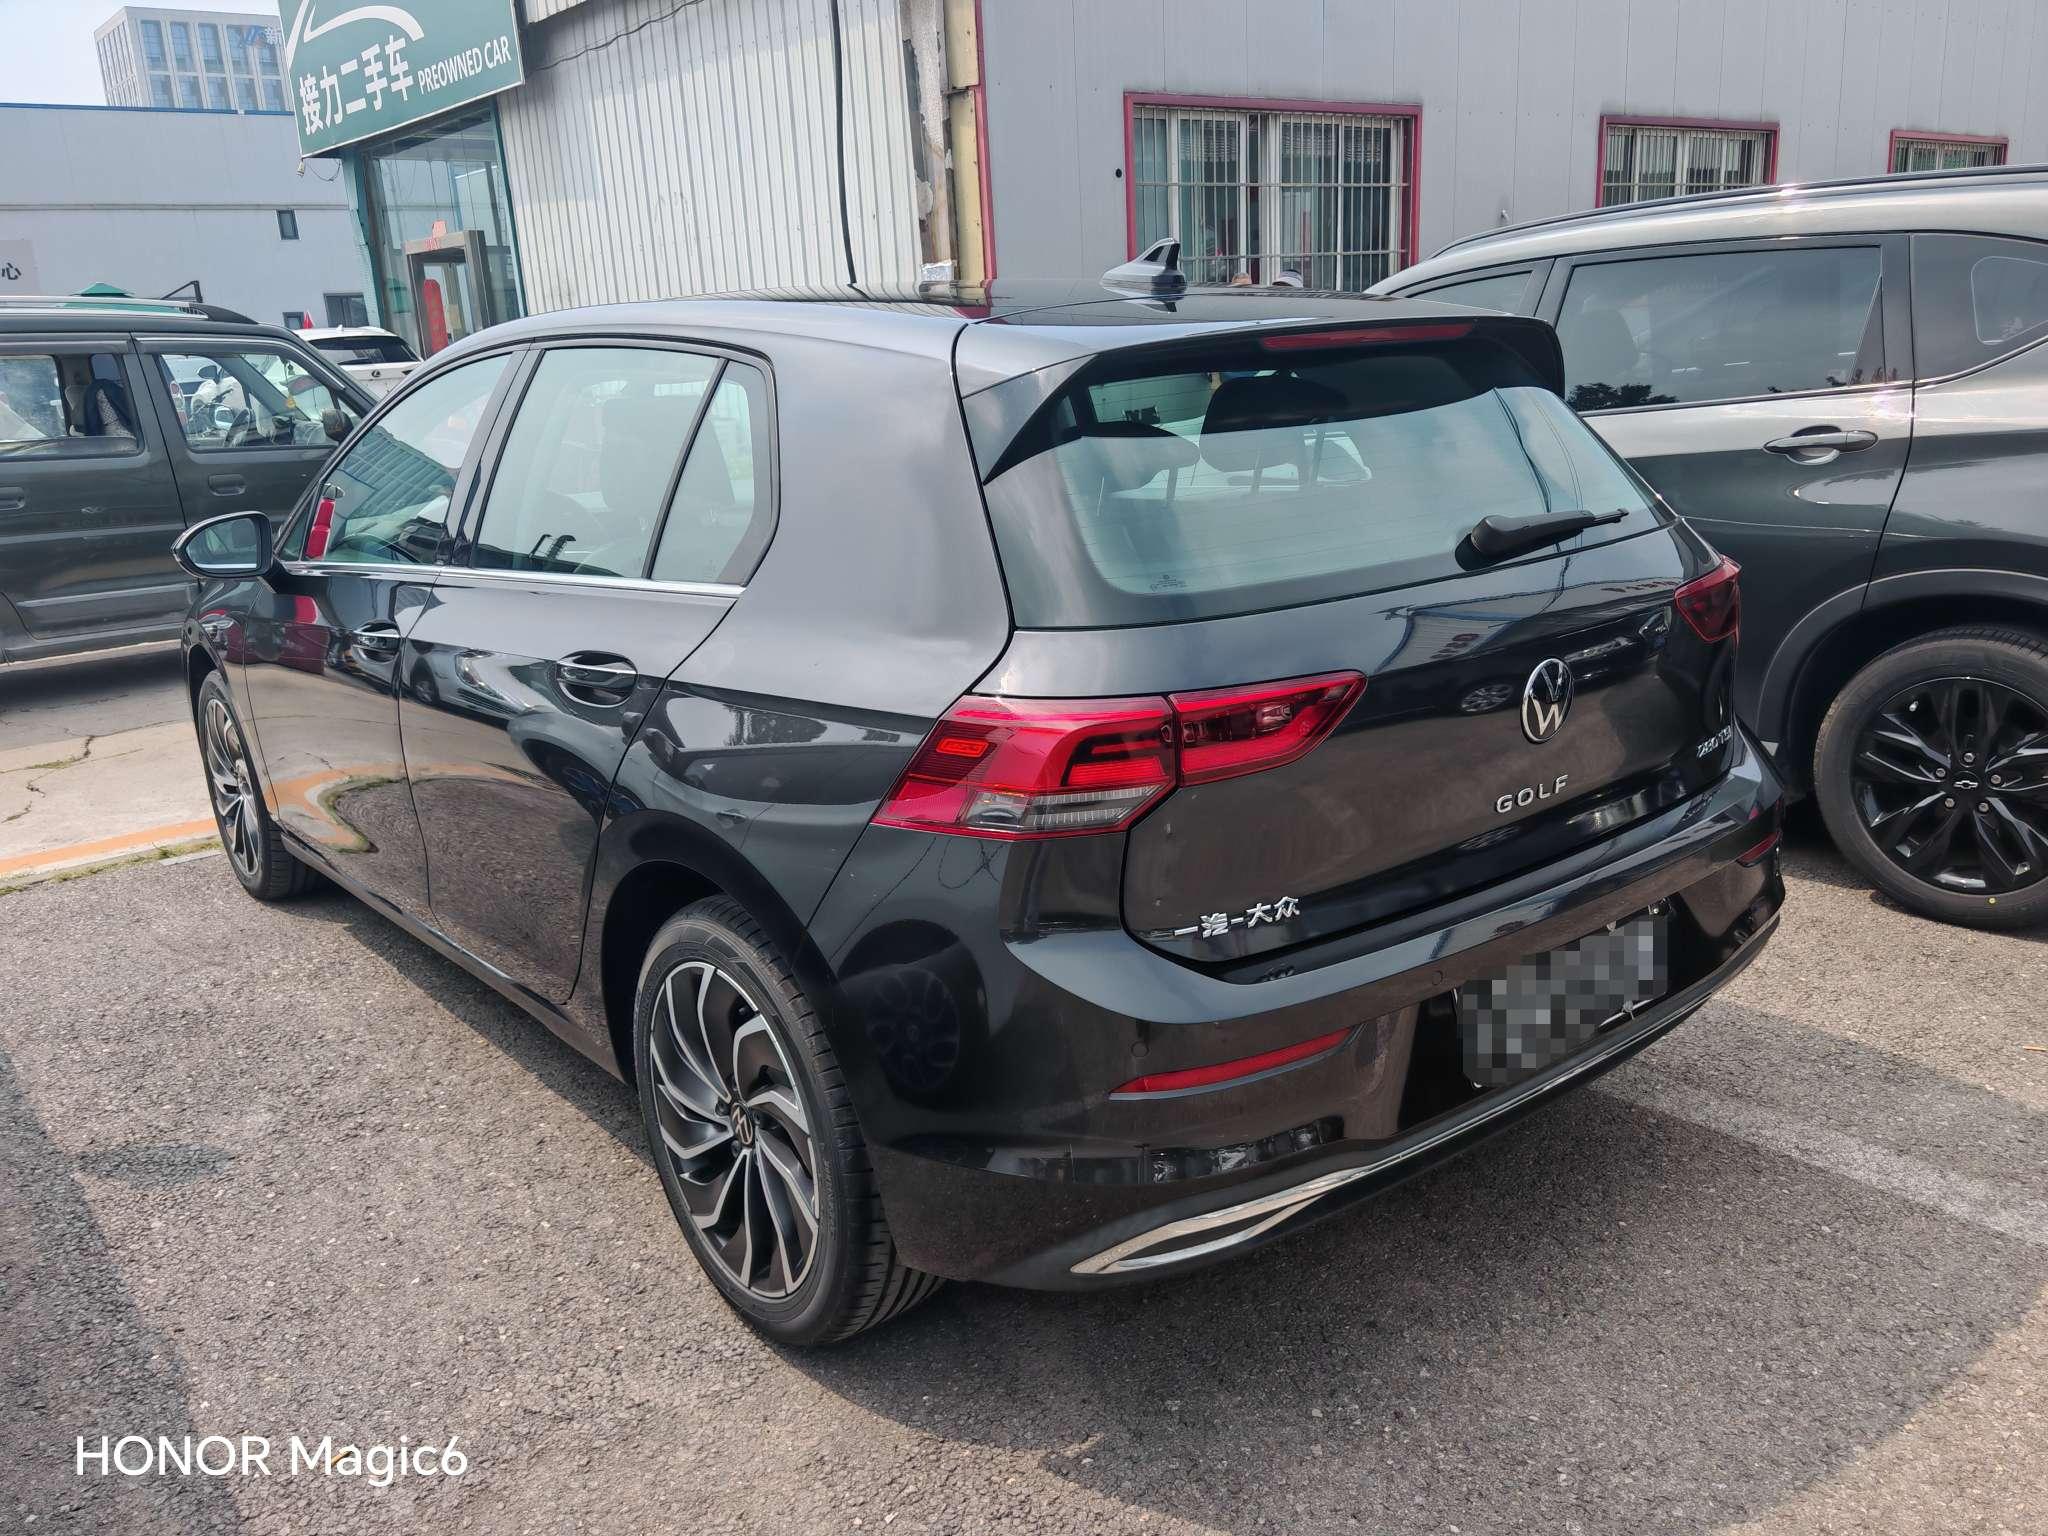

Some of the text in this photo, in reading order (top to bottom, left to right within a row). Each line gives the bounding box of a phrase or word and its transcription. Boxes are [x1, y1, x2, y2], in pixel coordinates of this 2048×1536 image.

[299, 34, 414, 136] 接力二手车
[417, 35, 512, 95] PREOWNED CAR
[1496, 774, 1569, 813] GOLF
